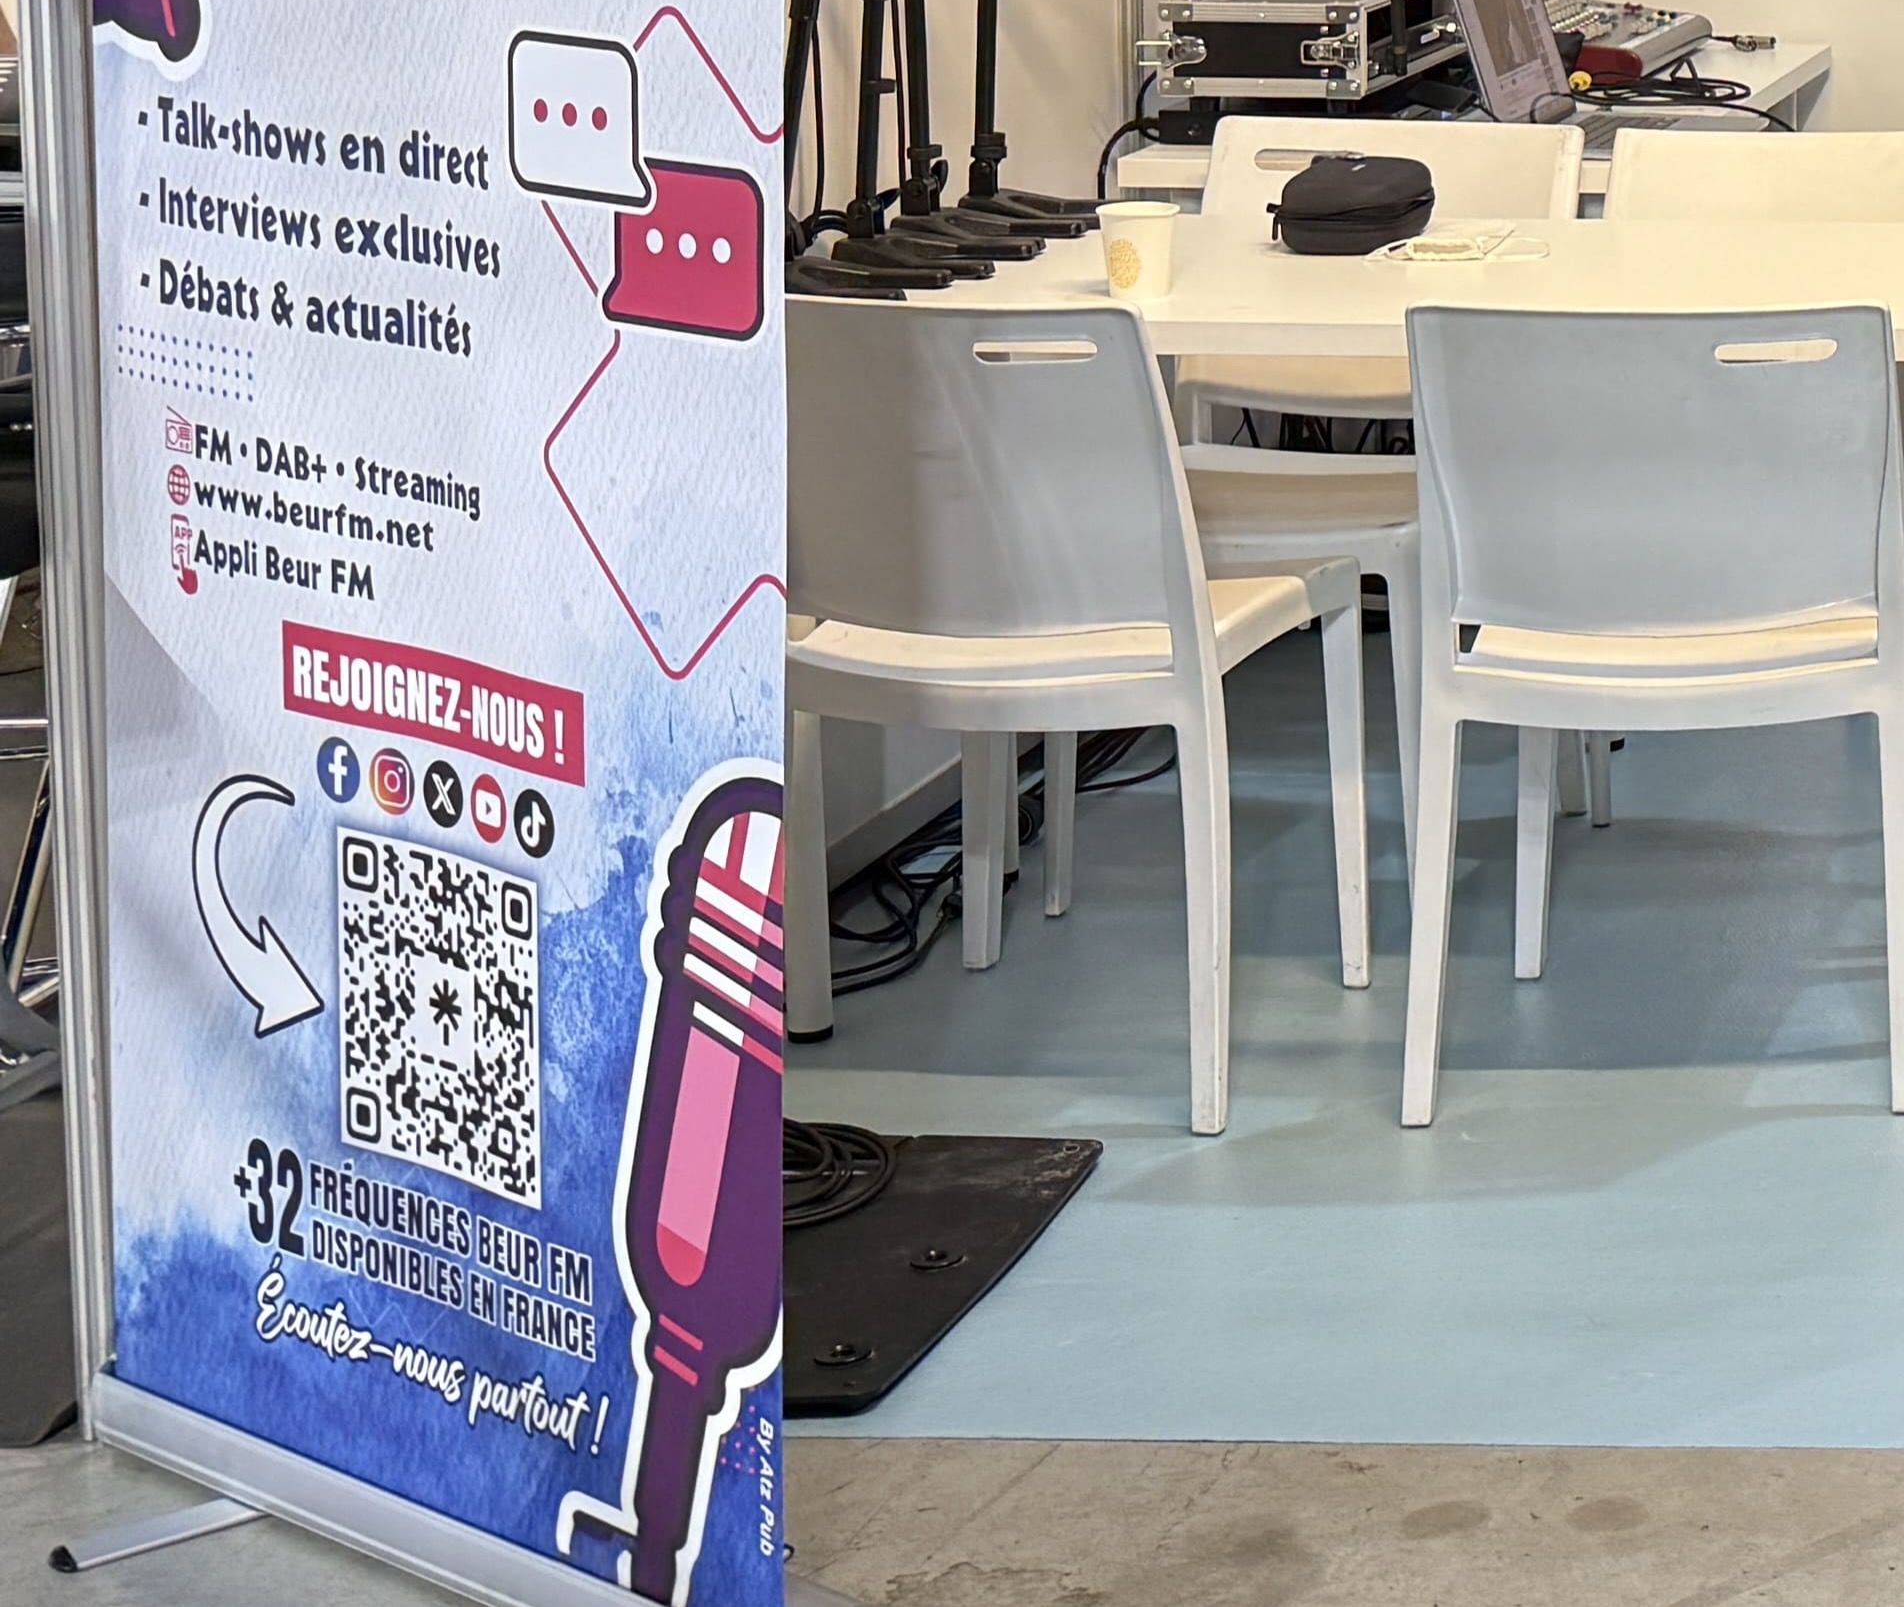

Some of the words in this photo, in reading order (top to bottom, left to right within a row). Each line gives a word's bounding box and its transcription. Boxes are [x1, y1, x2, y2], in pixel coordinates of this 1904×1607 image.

[157, 97, 326, 166] Talk-shows
[340, 130, 385, 176] en
[400, 130, 489, 191] direct
[158, 179, 321, 251] Interviews
[334, 213, 501, 279] exclusives
[158, 260, 259, 324] Débats
[271, 286, 293, 330] &
[305, 296, 472, 358] actualités
[194, 478, 435, 552] www.beurfm.net
[195, 424, 232, 466] FM
[256, 438, 328, 485] DAB+
[355, 455, 481, 521] Streaming
[194, 529, 257, 578] Appli
[265, 545, 322, 591] Beur
[331, 557, 375, 601] FM
[292, 643, 545, 759] REJOIGNEZ-NOUS
[309, 1159, 471, 1256] FRÉQUENCES
[478, 1212, 540, 1280] BEUR
[550, 1254, 592, 1304] FM
[311, 1218, 463, 1308] DISPONIBLES
[470, 1278, 498, 1319] EN
[502, 1290, 596, 1361] FRANCE
[256, 1254, 465, 1405] Écoutez-nous
[469, 1360, 590, 1449] partout
[757, 1417, 777, 1453] By
[759, 1461, 775, 1504] Atz
[759, 1507, 775, 1557] Pub
